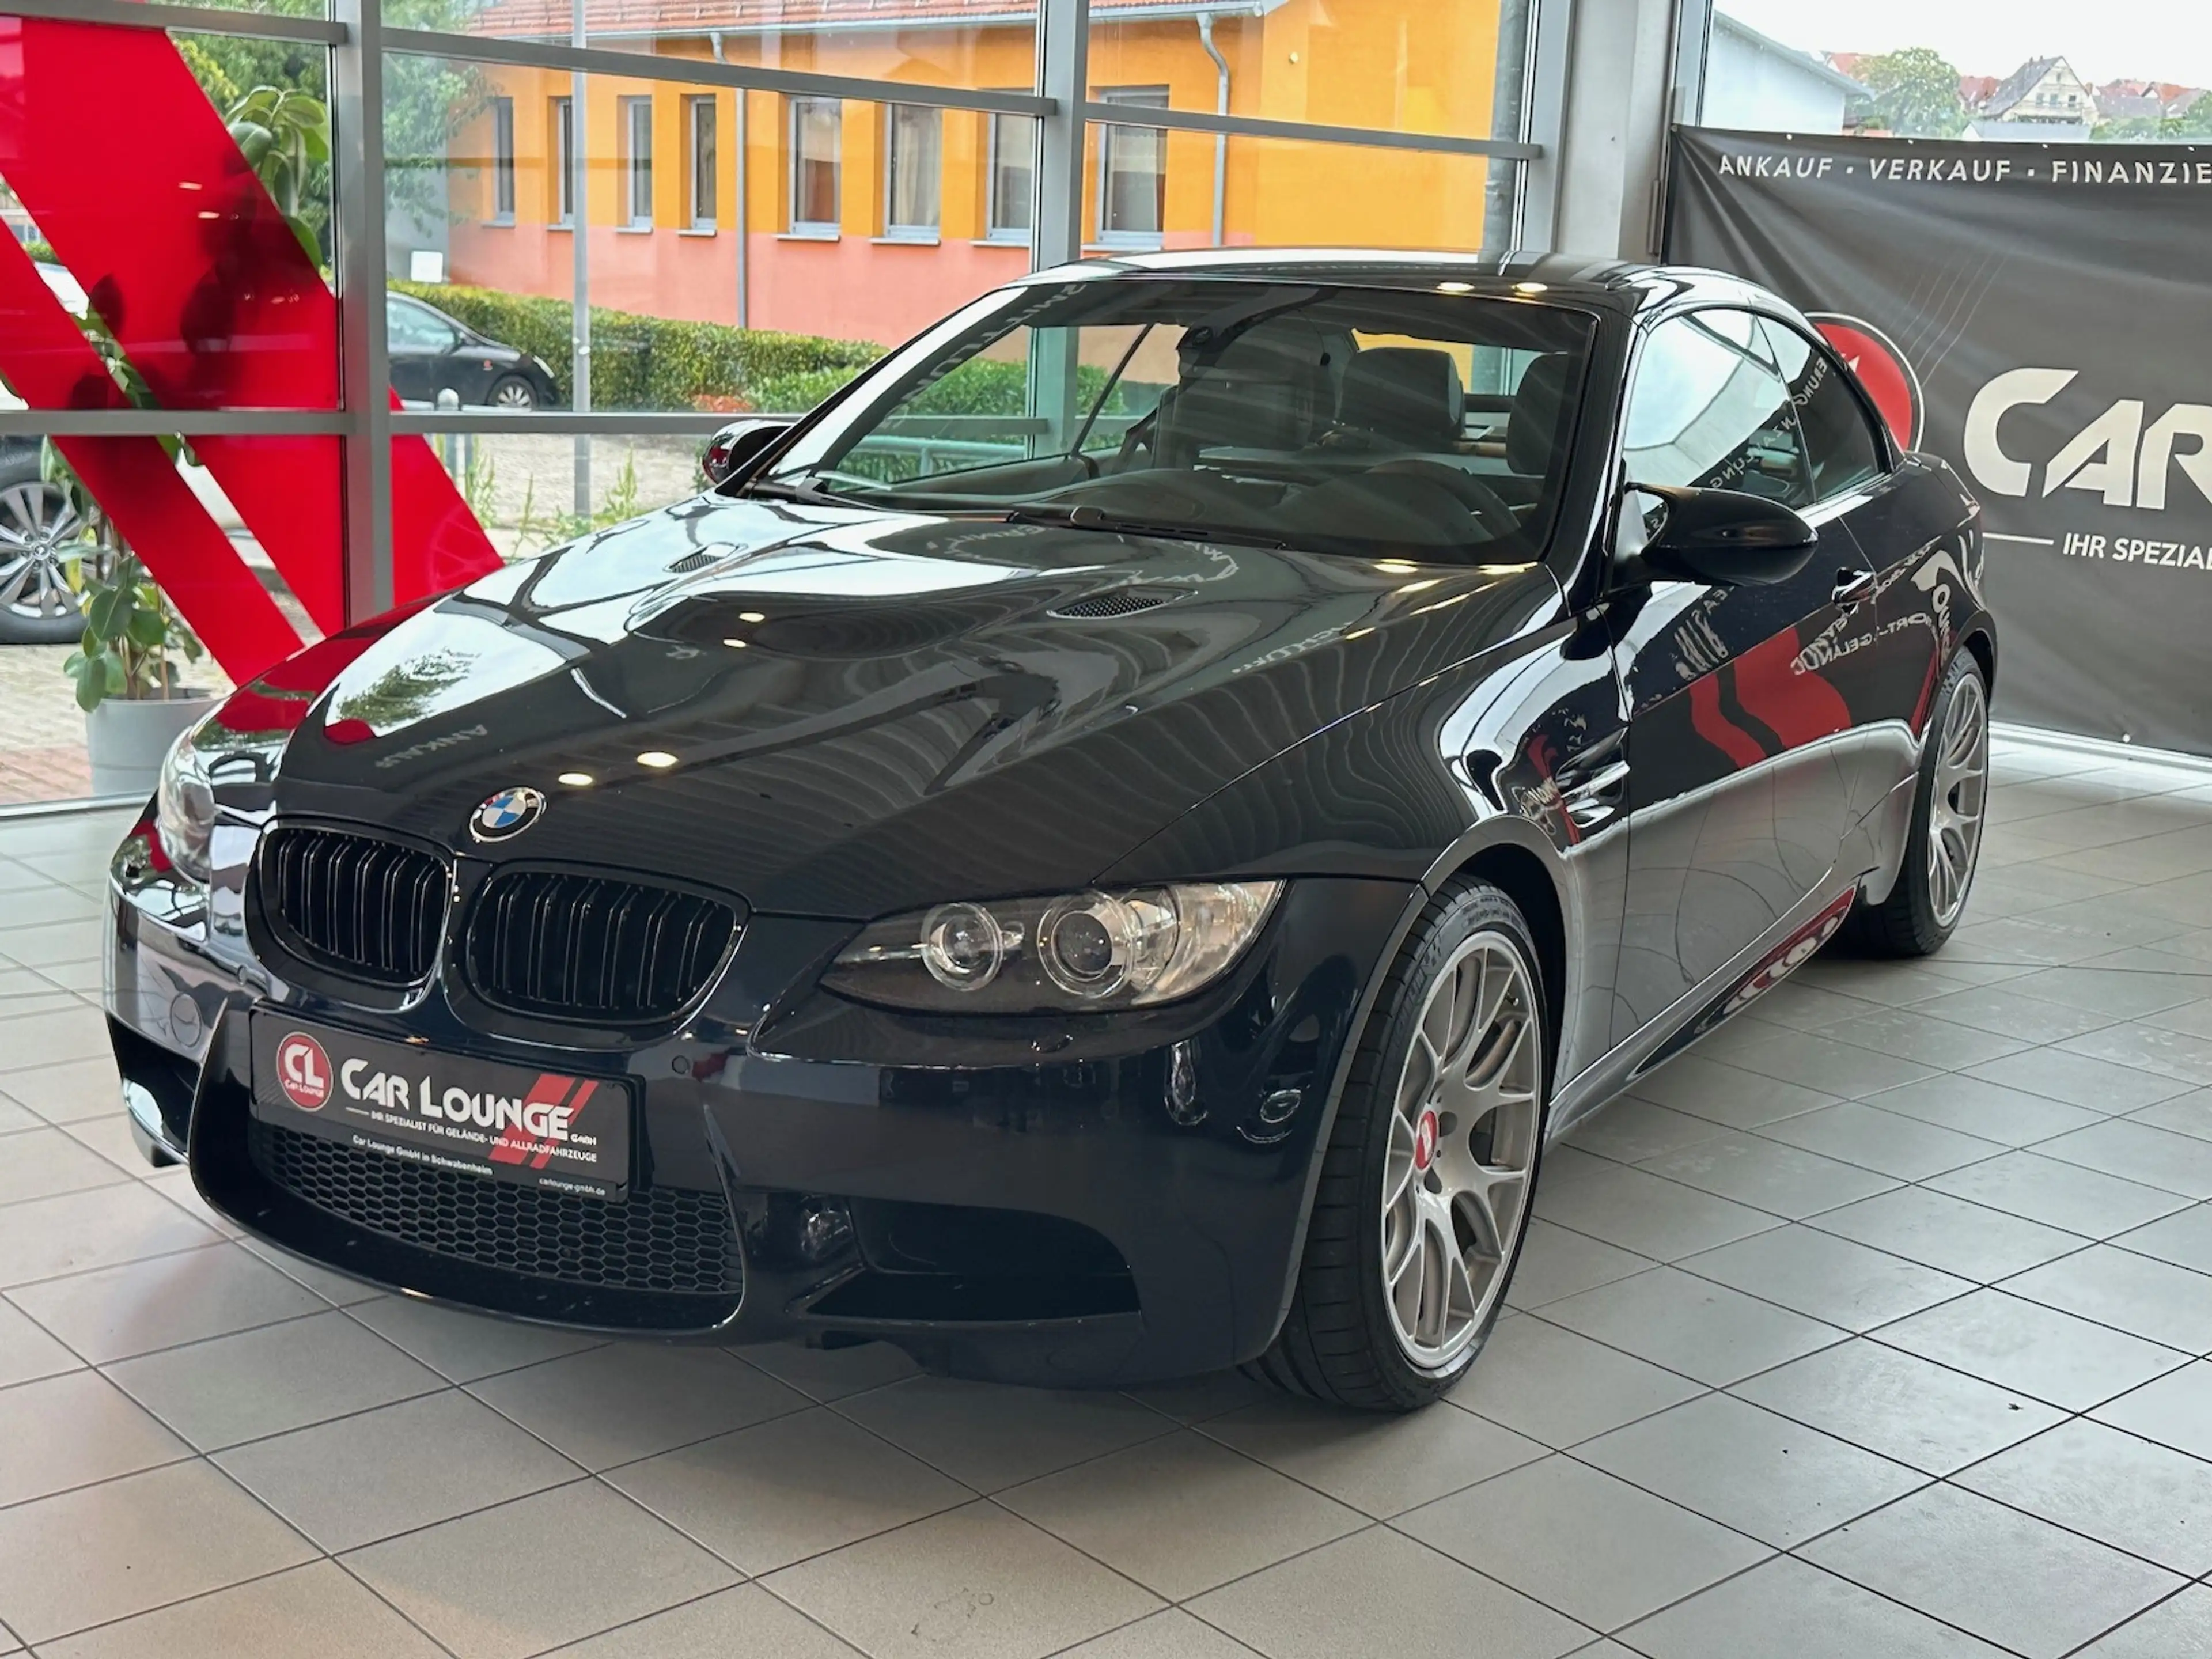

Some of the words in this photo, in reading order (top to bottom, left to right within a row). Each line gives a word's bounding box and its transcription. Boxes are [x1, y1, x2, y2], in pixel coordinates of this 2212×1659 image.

[1718, 154, 1833, 179] ANKAUF
[1869, 158, 2011, 182] VERKAUF
[2051, 160, 2212, 183] FINANZIE
[1963, 367, 2212, 510] CAR
[2062, 532, 2107, 558] IHR
[285, 1043, 324, 1089] CL
[341, 1058, 410, 1111] CAR
[419, 1075, 574, 1141] LOUNGE
[352, 1134, 365, 1146] Car
[367, 1138, 395, 1156] Lounge
[396, 1145, 421, 1161] GmbH
[422, 1152, 430, 1162] in
[431, 1153, 493, 1176] Schwabenheim
[385, 1113, 427, 1131] SPEZIALIST
[428, 1123, 445, 1136] FÜR
[445, 1127, 488, 1143] GELÄNDE-
[490, 1136, 509, 1148] UND
[510, 1138, 597, 1162] ALLRADFAHRZEUGE
